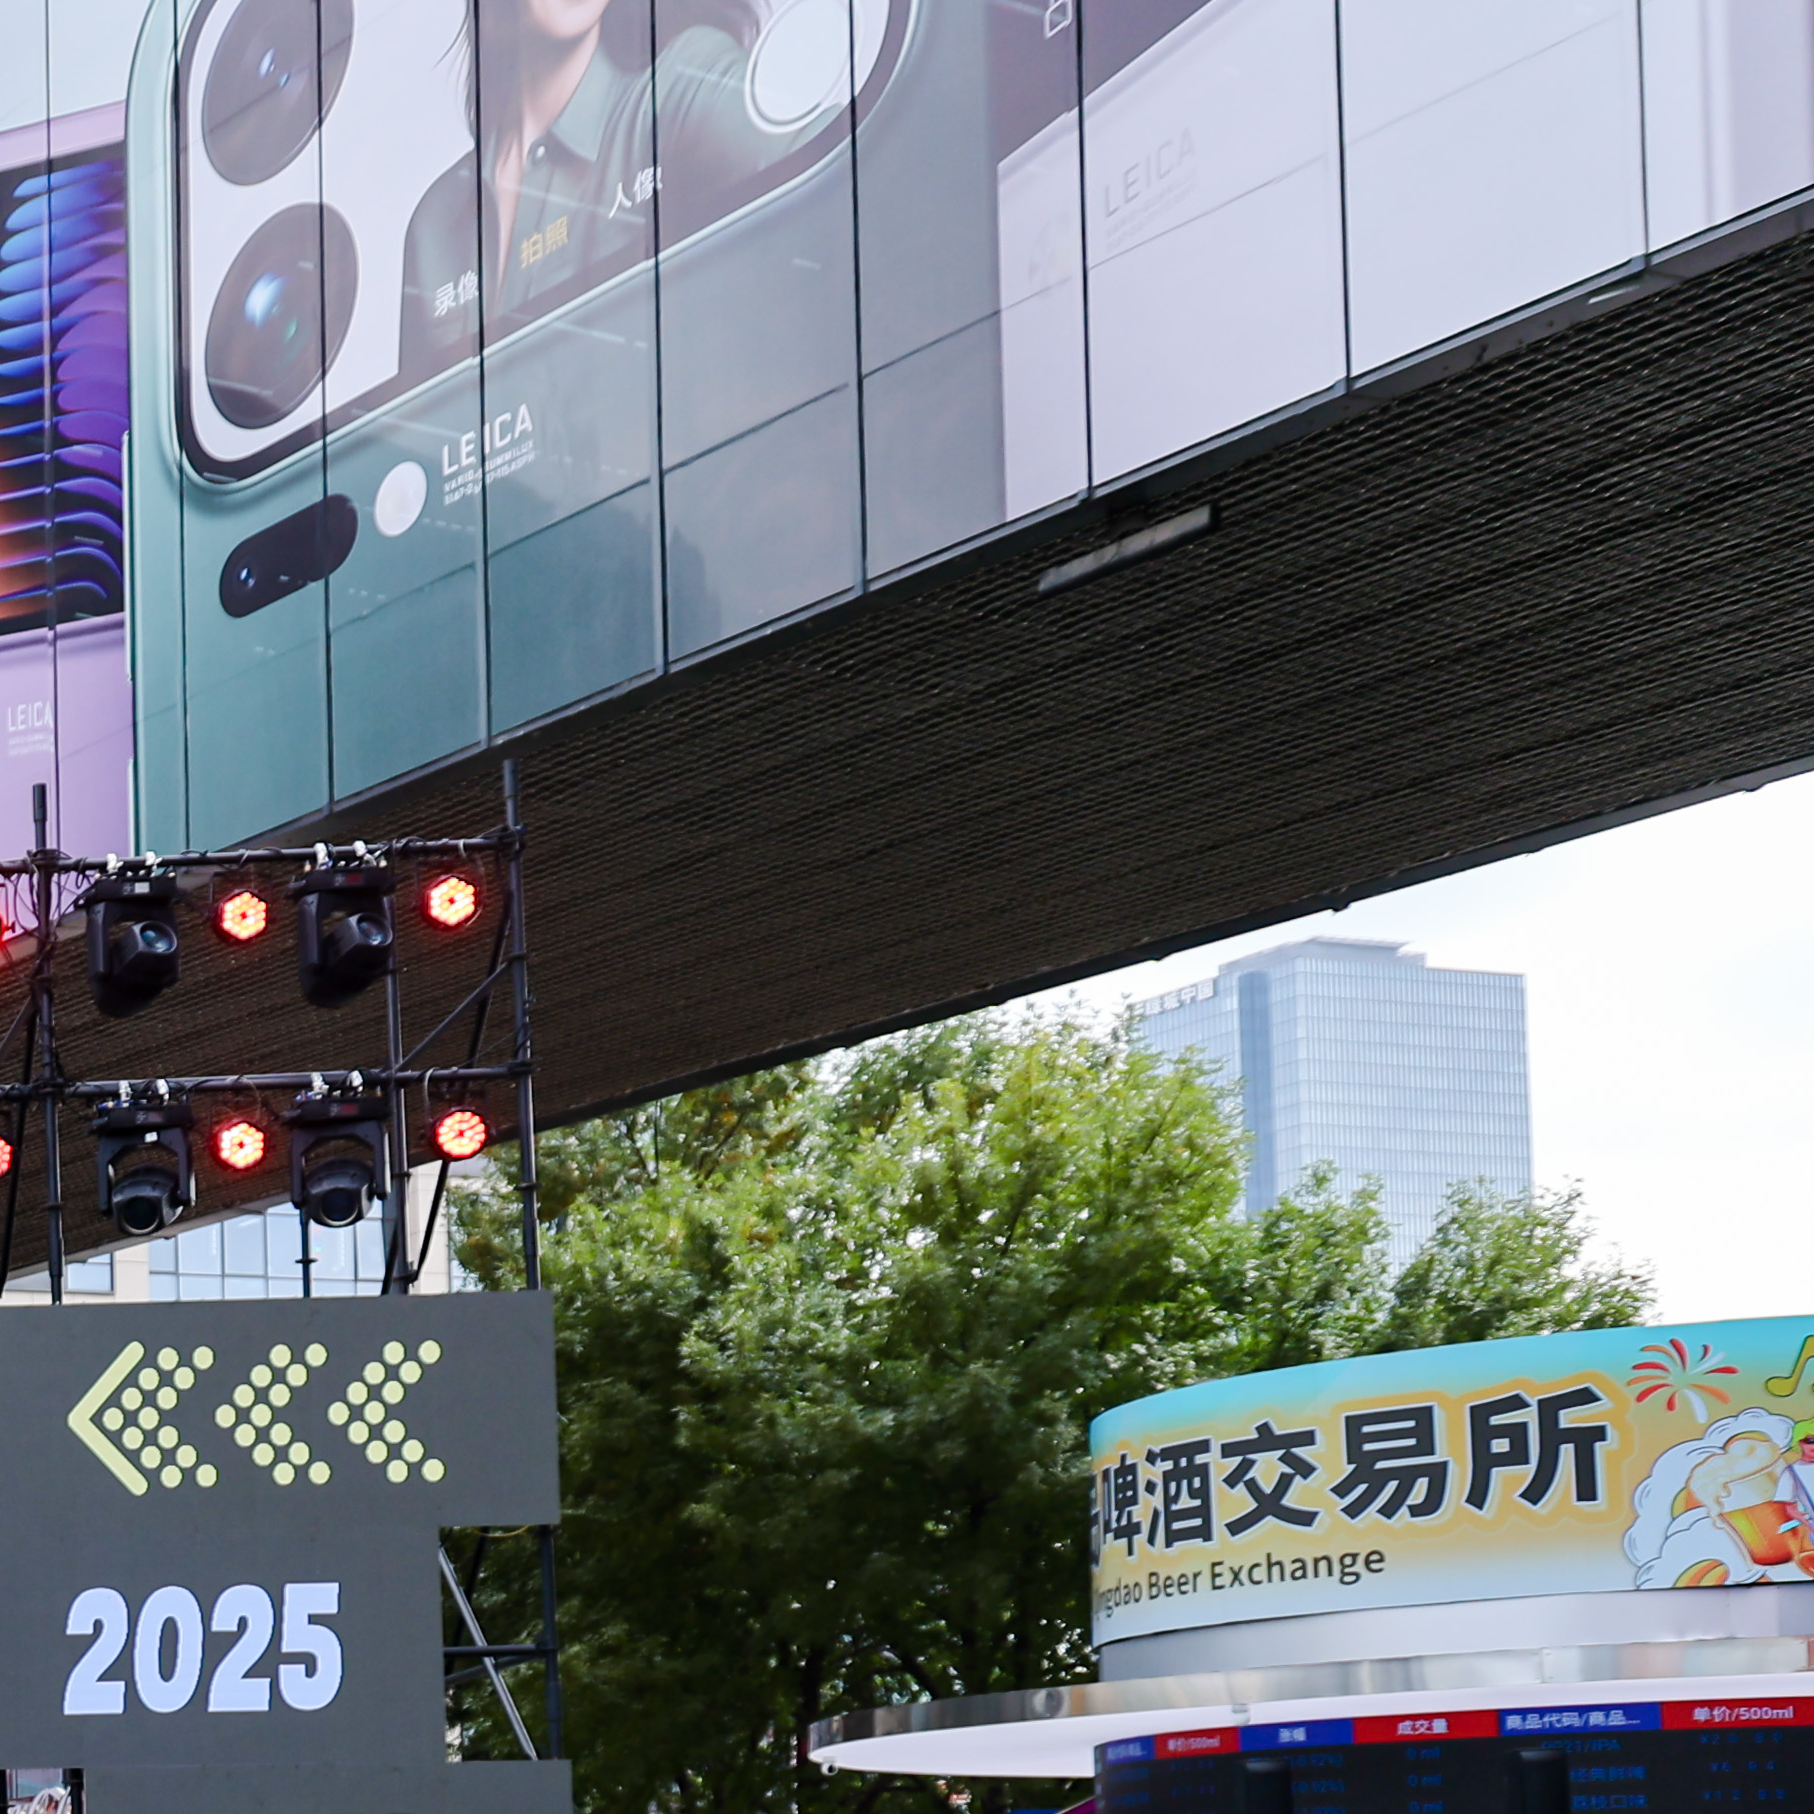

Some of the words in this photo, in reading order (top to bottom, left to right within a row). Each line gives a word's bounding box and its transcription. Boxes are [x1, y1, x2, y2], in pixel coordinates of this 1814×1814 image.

[608, 164, 663, 220] 人像
[1103, 126, 1196, 219] LEICA
[520, 214, 569, 270] 拍照
[433, 269, 479, 318] 录像
[441, 402, 533, 477] LEICA
[7, 700, 54, 732] LEICA
[1148, 1568, 1204, 1603] Beer
[1210, 1548, 1387, 1591] Exchange
[61, 1580, 346, 1718] 2025
[1396, 1718, 1450, 1736] 成交量
[1692, 1705, 1795, 1723] 单价/500ml
